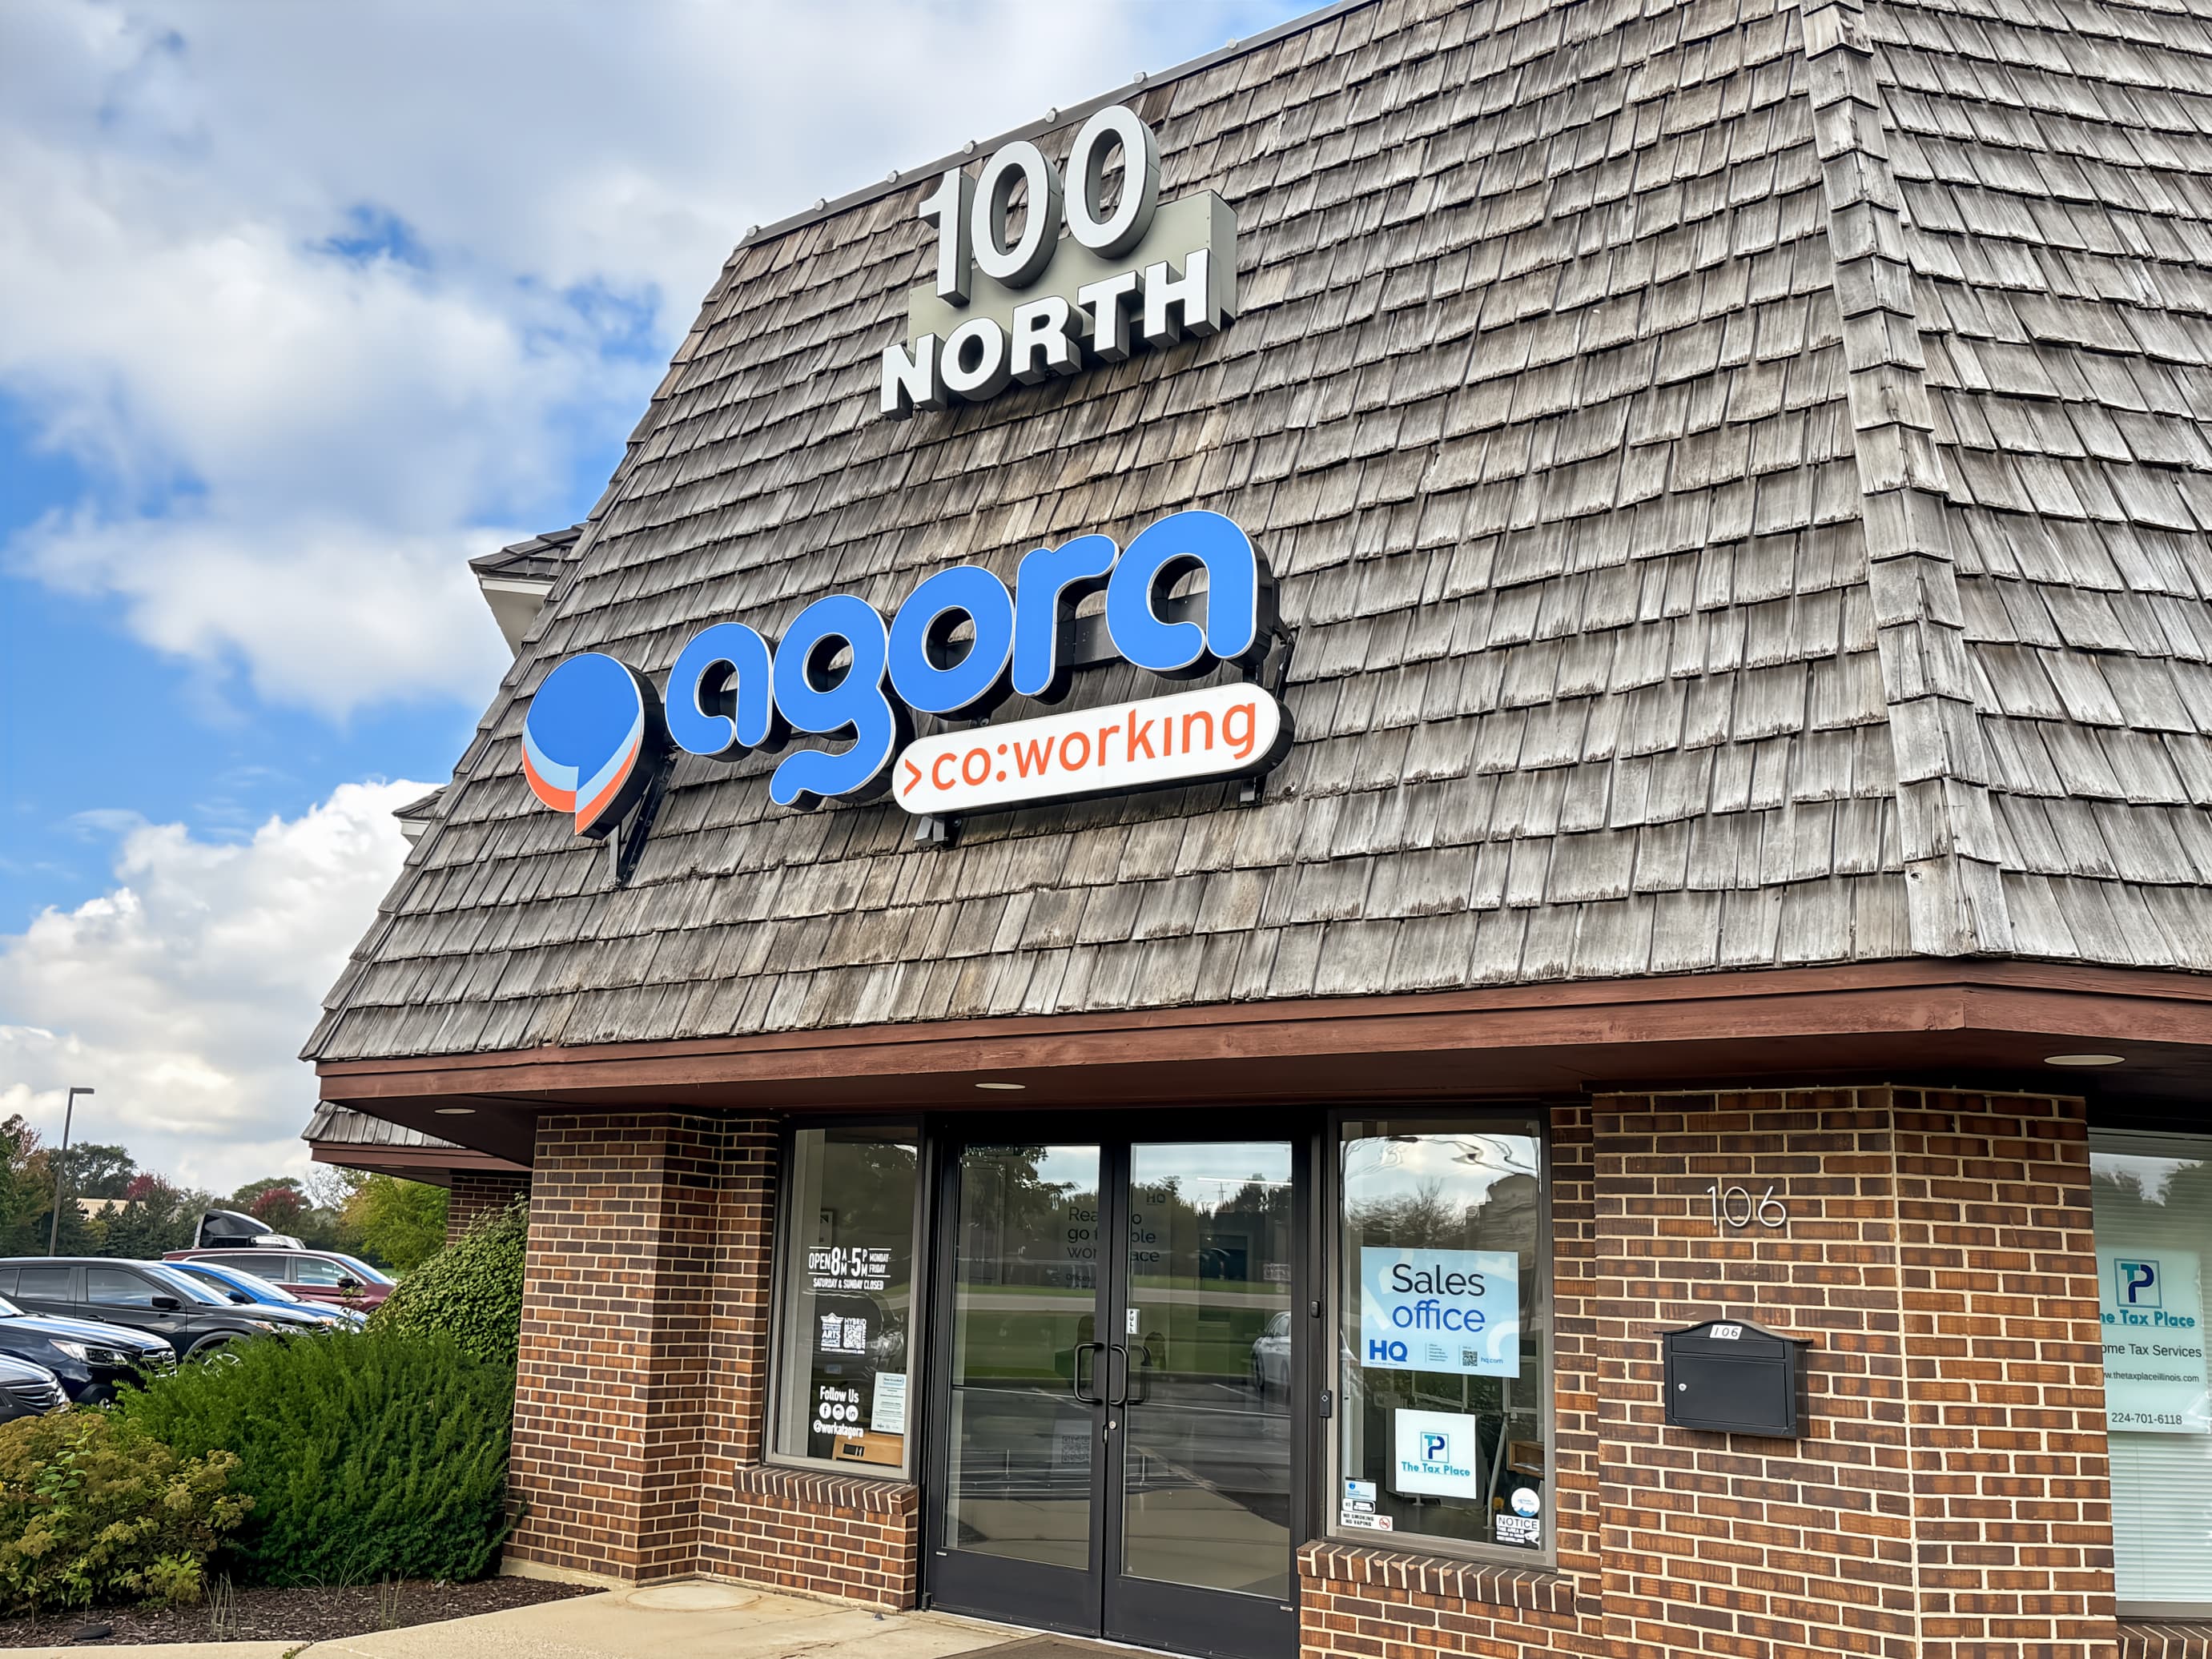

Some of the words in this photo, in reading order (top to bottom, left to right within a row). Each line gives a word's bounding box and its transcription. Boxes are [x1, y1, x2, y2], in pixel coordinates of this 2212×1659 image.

[919, 104, 1156, 303] 100
[880, 247, 1213, 418] NORTH
[665, 508, 1259, 808] agora
[1707, 1185, 1787, 1227] 106
[1068, 1207, 1099, 1223] Rea
[1130, 1213, 1142, 1225] o
[1068, 1228, 1090, 1243] go
[808, 1252, 831, 1270] OPEN
[868, 1264, 886, 1274] FRIDAY
[813, 1278, 838, 1288] SATURDAY
[843, 1279, 863, 1290] SUNDAY
[864, 1280, 884, 1291] CLOSED
[1392, 1263, 1486, 1297] Sales
[1392, 1299, 1486, 1333] office
[2119, 1309, 2149, 1326] Tax
[2154, 1311, 2195, 1328] Place
[821, 1329, 841, 1340] ARTS
[1713, 1327, 1739, 1338] 106
[1369, 1339, 1408, 1362] HQ
[2128, 1343, 2150, 1356] Tax
[2152, 1344, 2202, 1358] Services
[819, 1385, 847, 1402] Follow
[848, 1388, 859, 1404] Us
[2111, 1412, 2183, 1425] 224-701-6118
[813, 1420, 864, 1440] @workatagora
[1401, 1461, 1419, 1472] The
[1422, 1463, 1440, 1474] Tax
[1443, 1464, 1470, 1476] Place
[1498, 1516, 1538, 1530] NOTICE
